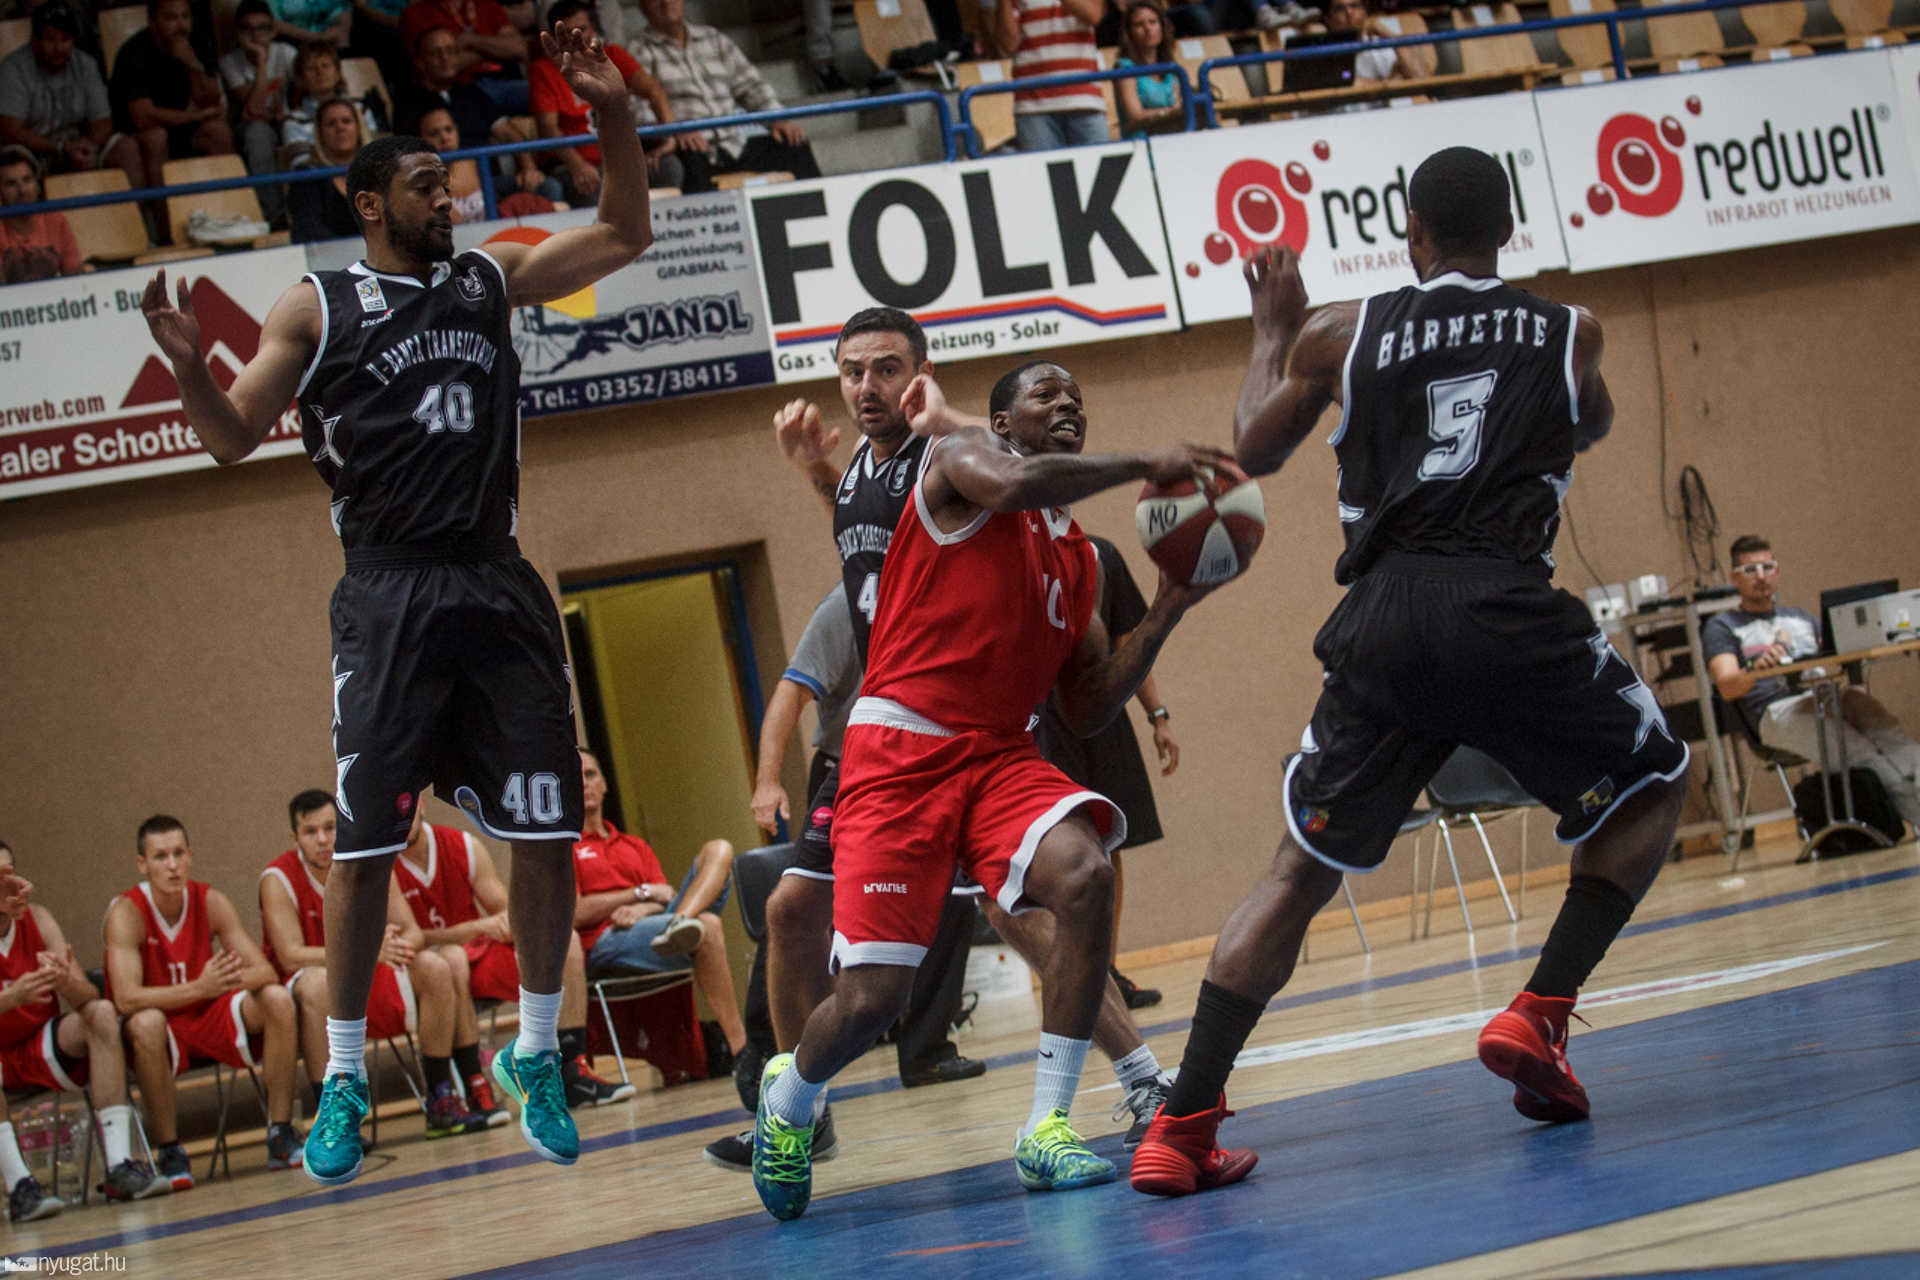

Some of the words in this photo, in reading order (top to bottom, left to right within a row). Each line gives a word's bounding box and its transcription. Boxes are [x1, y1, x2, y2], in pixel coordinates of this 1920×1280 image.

[1694, 106, 1885, 200] redwell
[666, 204, 737, 222] Fußböden
[1321, 151, 1526, 249] redl
[1706, 198, 1789, 226] INFRAROT
[1794, 184, 1893, 214] HEIZUNGEN
[633, 241, 744, 263] andverkleidung
[652, 228, 695, 242] üchen
[712, 221, 740, 236] Bad
[751, 152, 1159, 326] FOLK
[656, 259, 728, 279] GRABMAL
[1333, 251, 1412, 275] INFRARO
[622, 291, 753, 350] JANDL
[1376, 306, 1548, 370] BARNETTE
[0, 341, 21, 362] 57
[778, 352, 815, 371] Gas
[1011, 319, 1061, 340] Solar
[585, 361, 738, 404] 03352/38415
[411, 381, 475, 434] 40
[1417, 368, 1498, 482] 5
[0, 443, 64, 479] aler
[502, 772, 563, 825] 40
